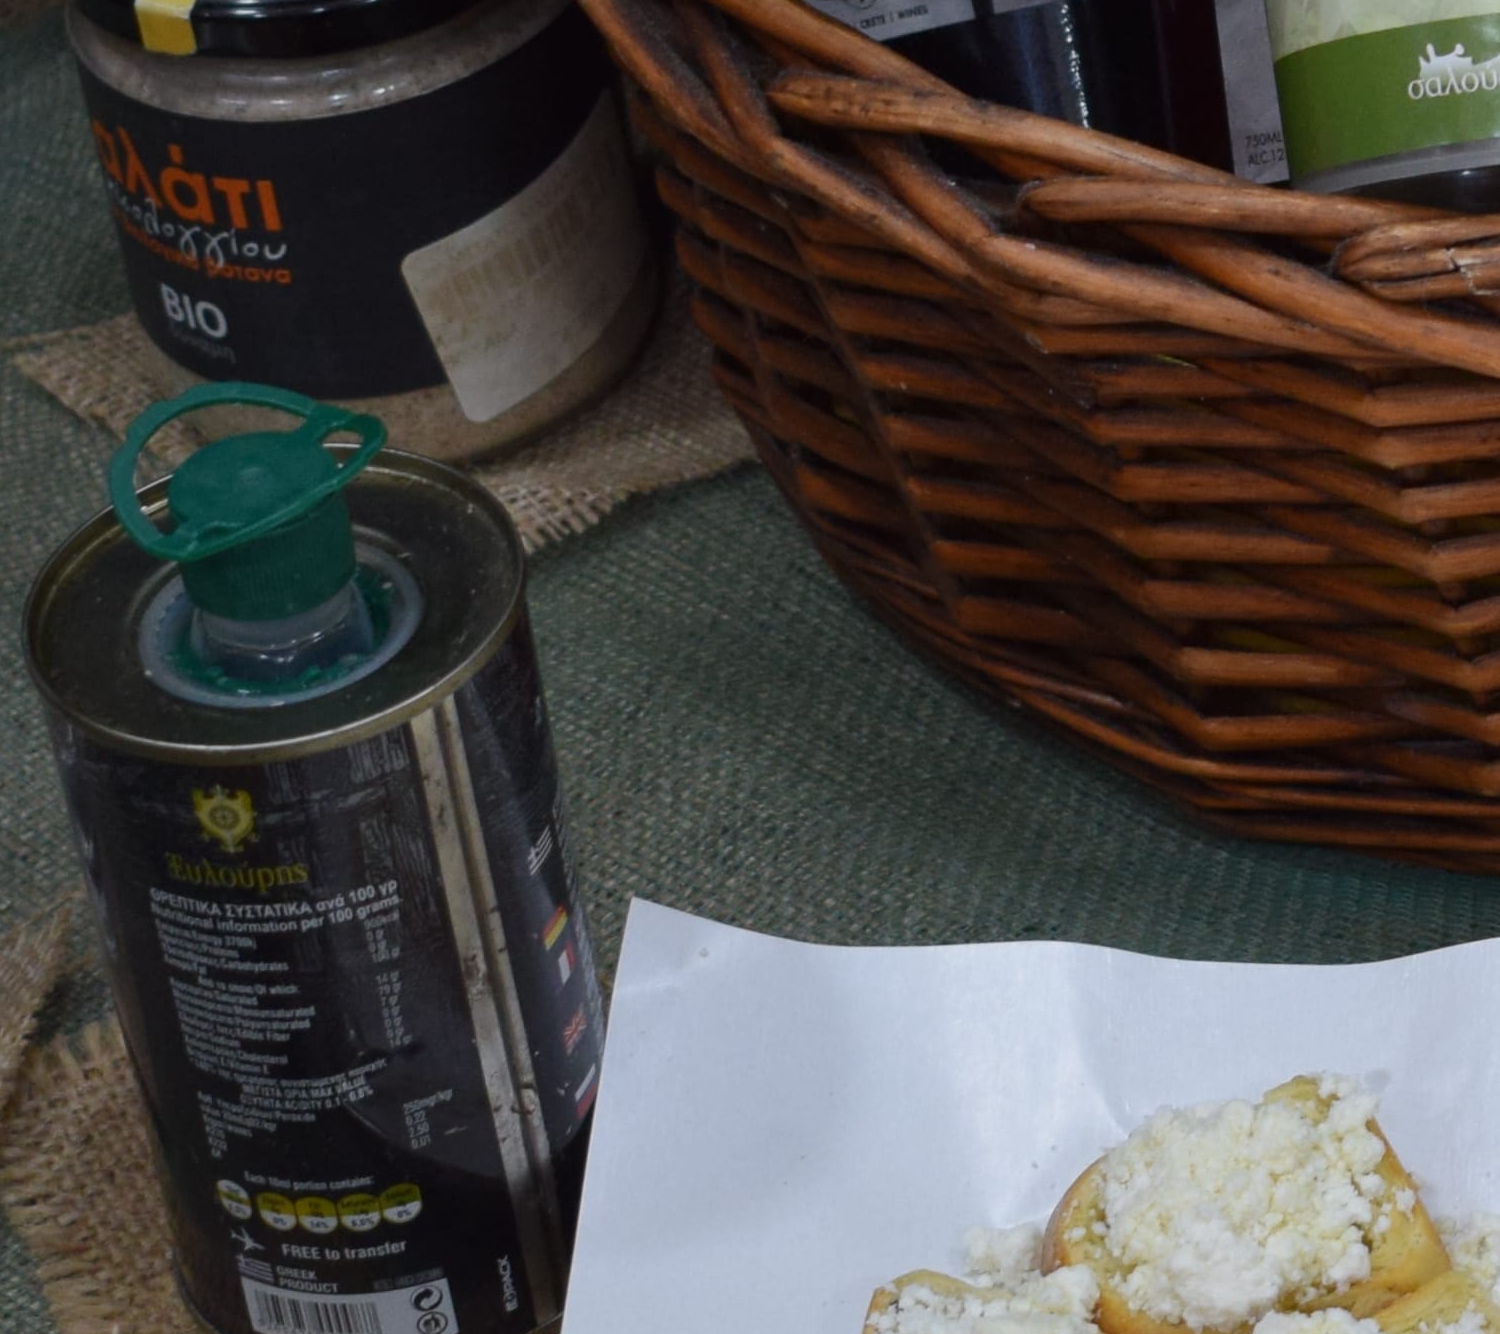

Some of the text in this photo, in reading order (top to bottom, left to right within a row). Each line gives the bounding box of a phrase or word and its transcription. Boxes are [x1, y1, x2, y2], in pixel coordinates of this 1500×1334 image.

[1245, 132, 1284, 149] 750ML
[92, 120, 282, 232] αλάτι
[159, 282, 229, 339] BIO
[150, 886, 222, 917] ΘΡΕΠΤΙΚΑ
[225, 901, 313, 919] ΣΥΣΤΑΤΙΚΑ
[316, 893, 345, 912] ανά
[348, 885, 375, 904] 100
[150, 902, 213, 929] Nutritional
[217, 915, 298, 933] information
[301, 914, 324, 933] per
[328, 907, 353, 925] 100
[281, 1240, 407, 1260] FREE to transfer
[277, 1265, 317, 1280] GREEK
[278, 1277, 339, 1294] PRODUCT
